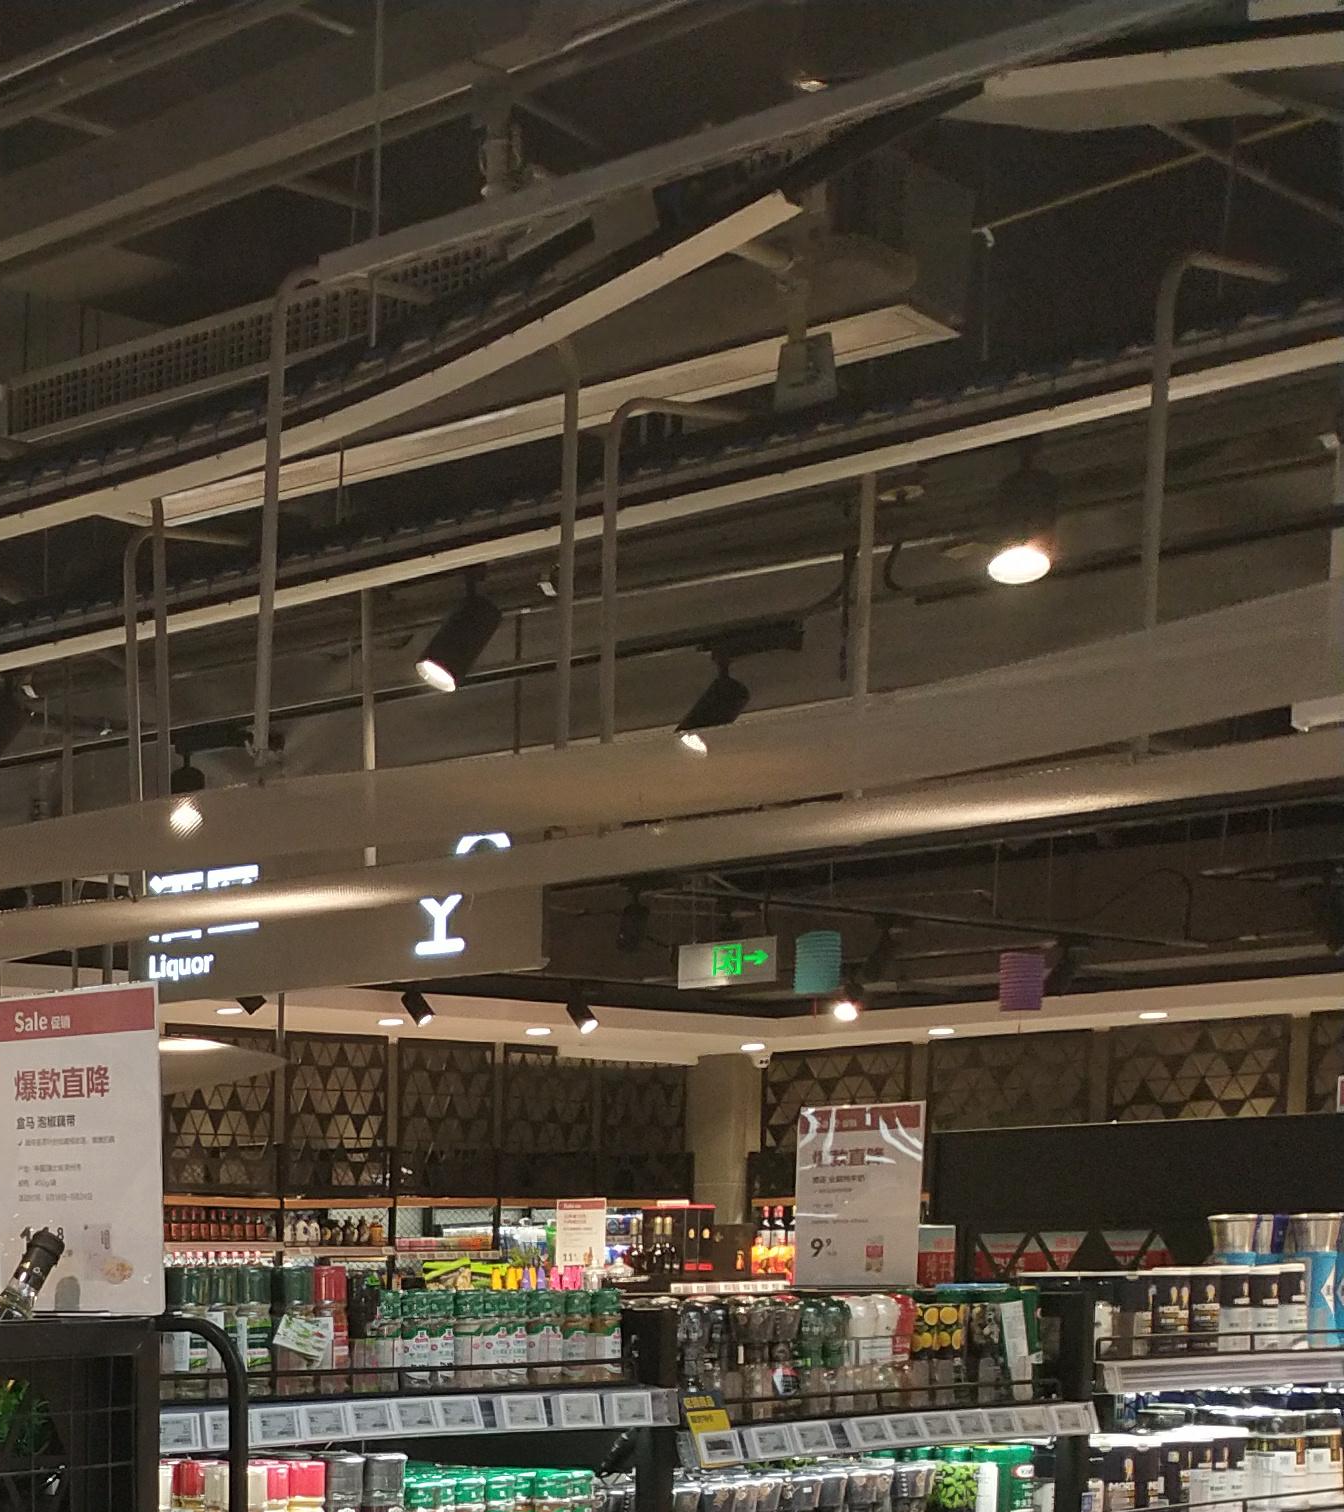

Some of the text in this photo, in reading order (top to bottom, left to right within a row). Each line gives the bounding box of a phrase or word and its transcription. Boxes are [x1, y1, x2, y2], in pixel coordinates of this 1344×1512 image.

[149, 953, 214, 981] Liquor
[14, 1011, 48, 1033] Sale
[14, 1064, 110, 1101] 爆款直降
